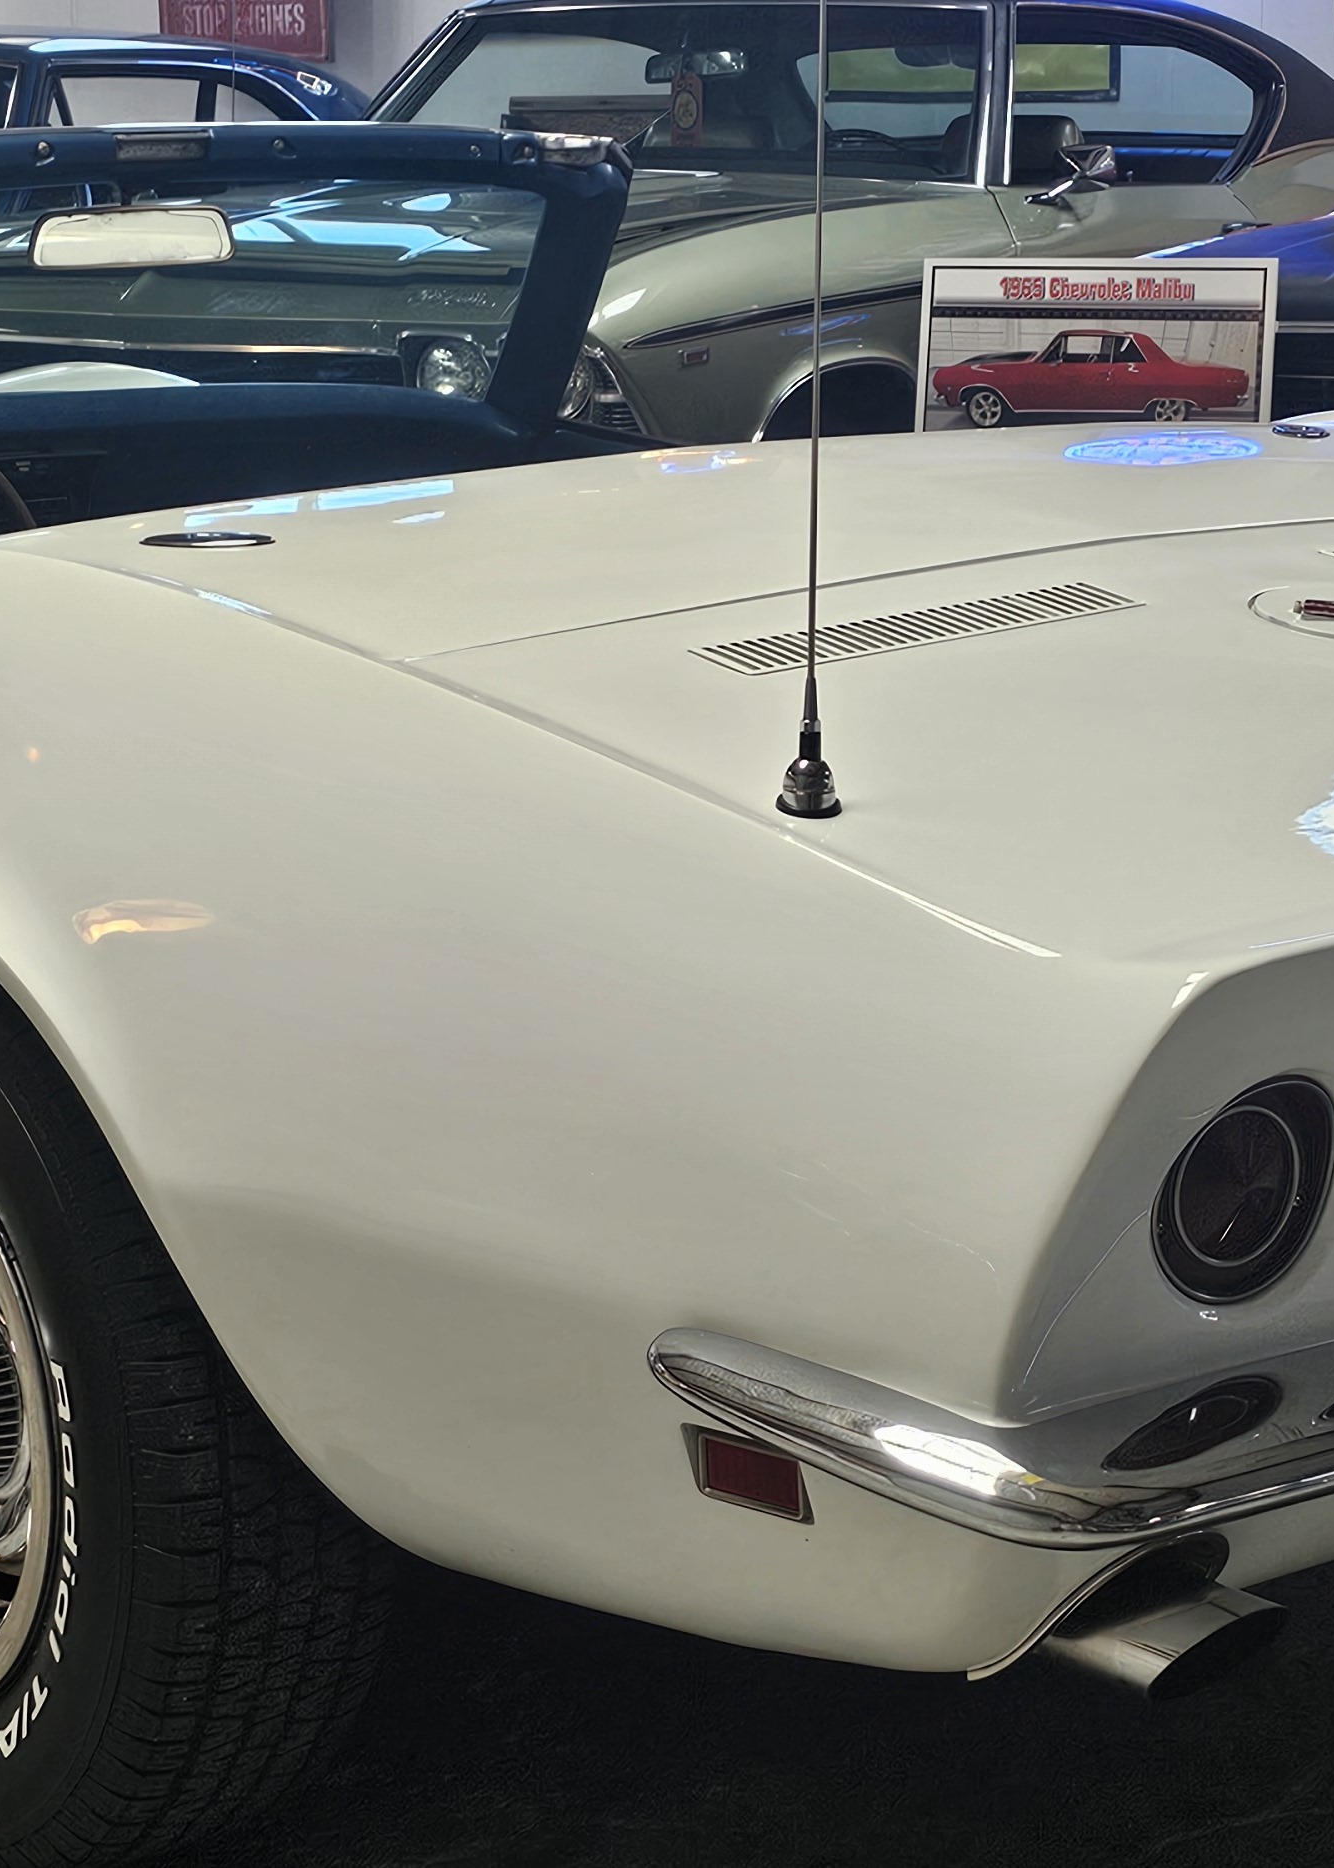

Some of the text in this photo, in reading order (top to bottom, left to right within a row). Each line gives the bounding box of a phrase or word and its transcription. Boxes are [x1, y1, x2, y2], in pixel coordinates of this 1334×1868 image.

[183, 4, 226, 35] STOP
[1049, 276, 1132, 300] Chevrolet
[1135, 277, 1195, 300] Malibu
[50, 1360, 78, 1663] Radial
